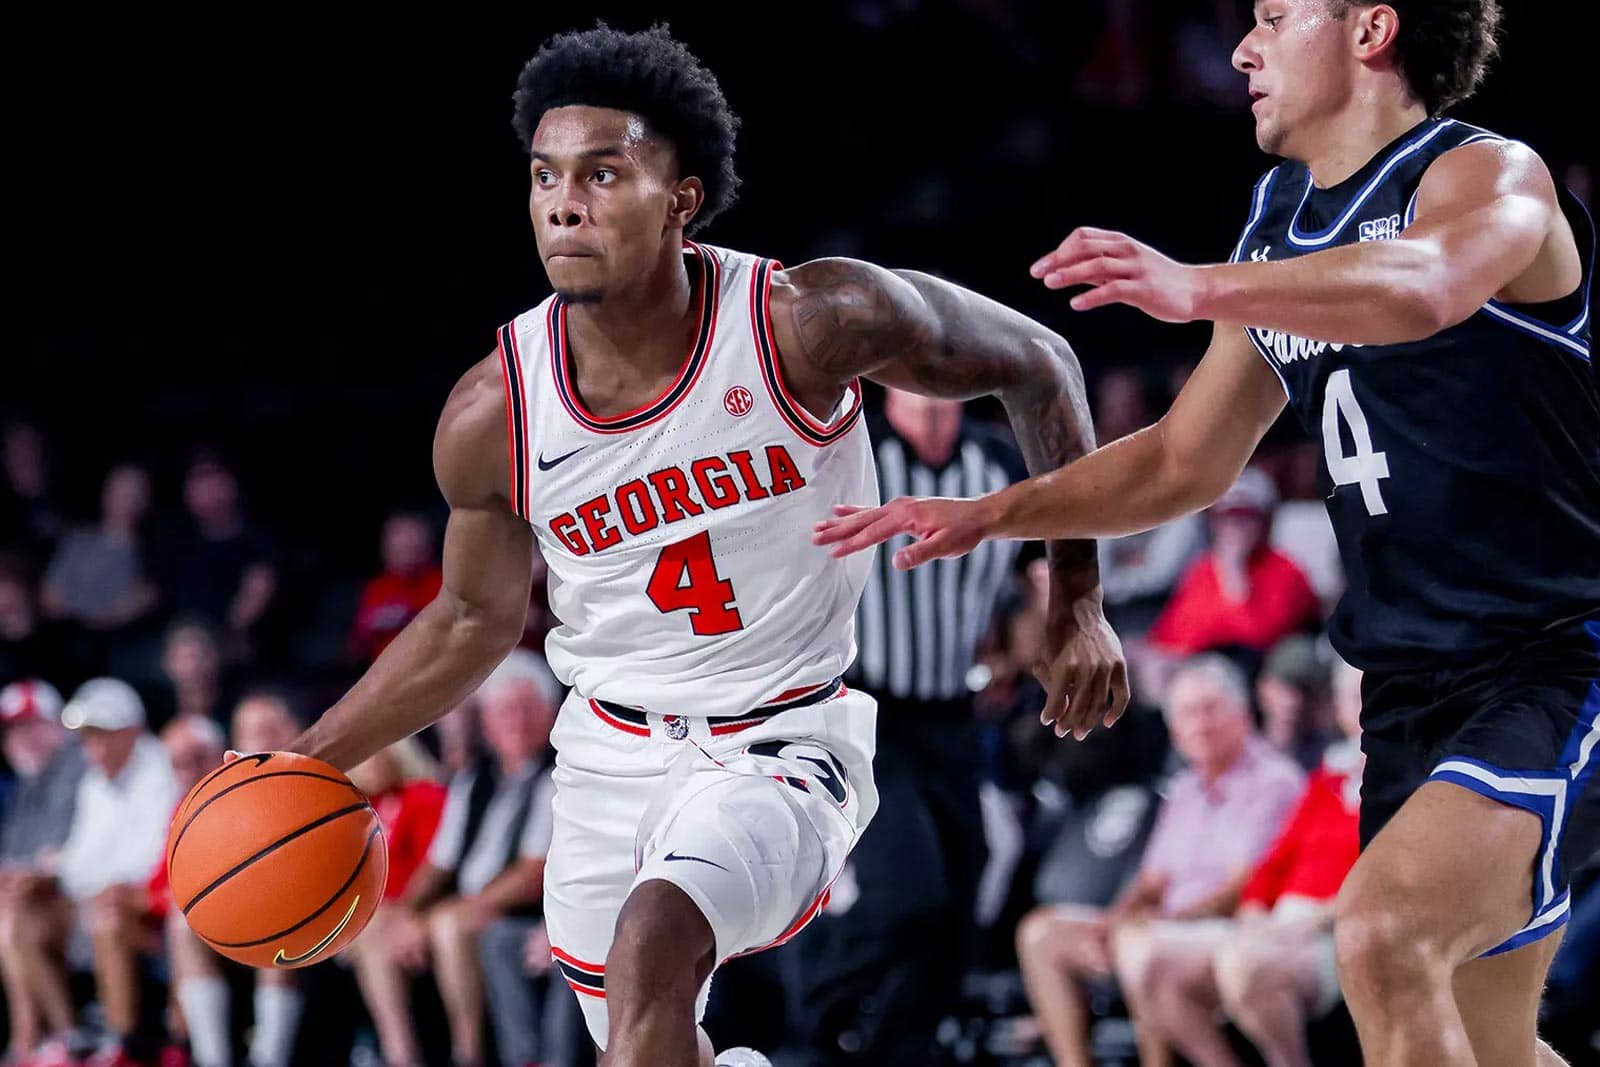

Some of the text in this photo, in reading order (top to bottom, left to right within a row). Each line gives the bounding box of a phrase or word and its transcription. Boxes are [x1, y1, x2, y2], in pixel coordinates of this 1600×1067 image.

[725, 388, 751, 415] SEC
[1321, 368, 1390, 516] 4
[549, 445, 806, 556] GEORGIA
[646, 529, 744, 636] 4
